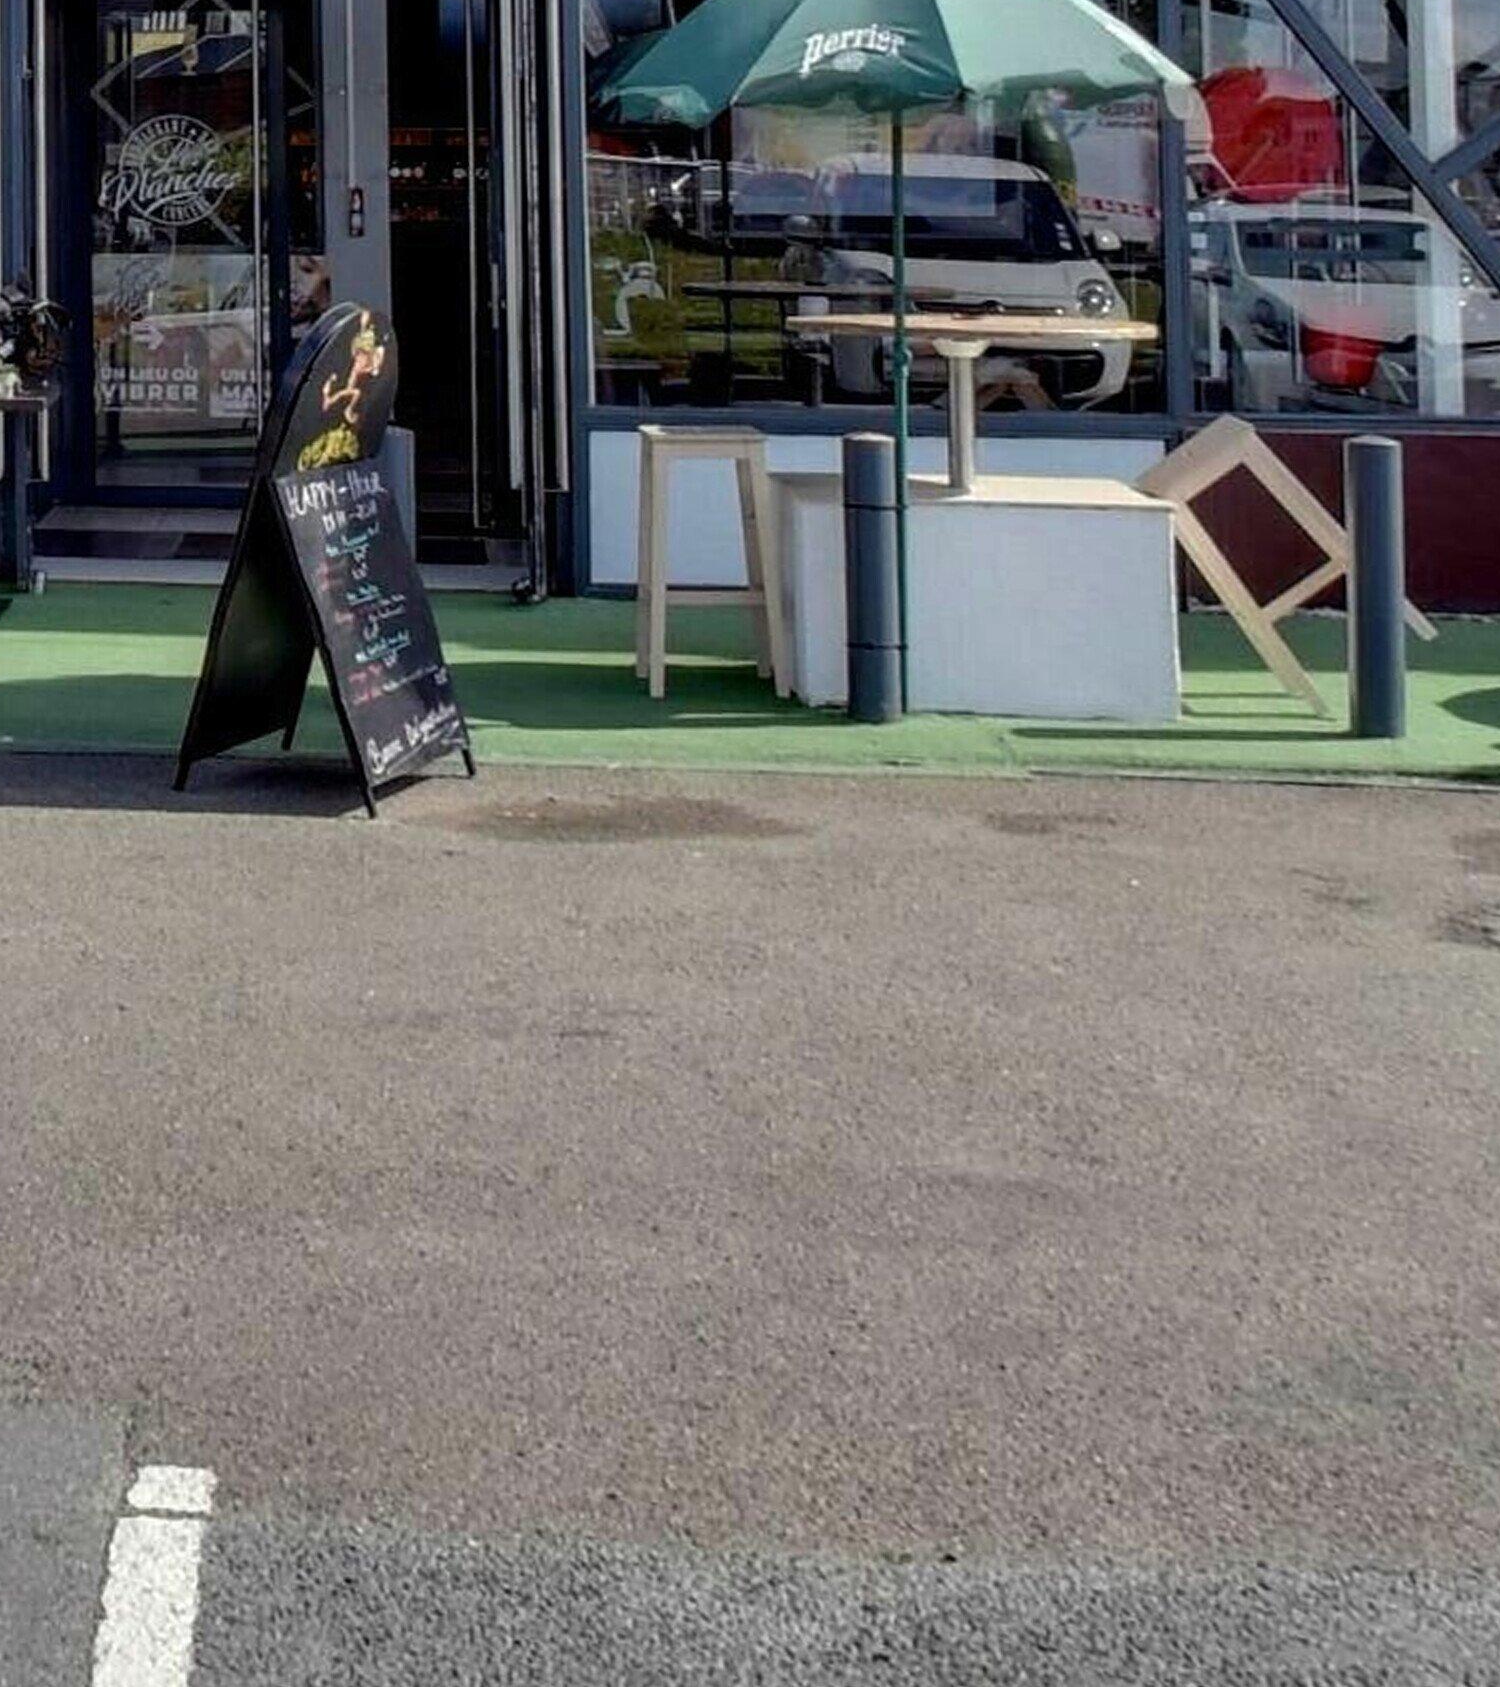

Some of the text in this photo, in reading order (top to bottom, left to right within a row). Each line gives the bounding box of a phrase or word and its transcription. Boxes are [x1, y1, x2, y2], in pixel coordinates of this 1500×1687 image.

[98, 159, 242, 223] Planches
[101, 366, 126, 382] UN
[130, 366, 169, 382] LIEU
[101, 383, 199, 402] VIBRER
